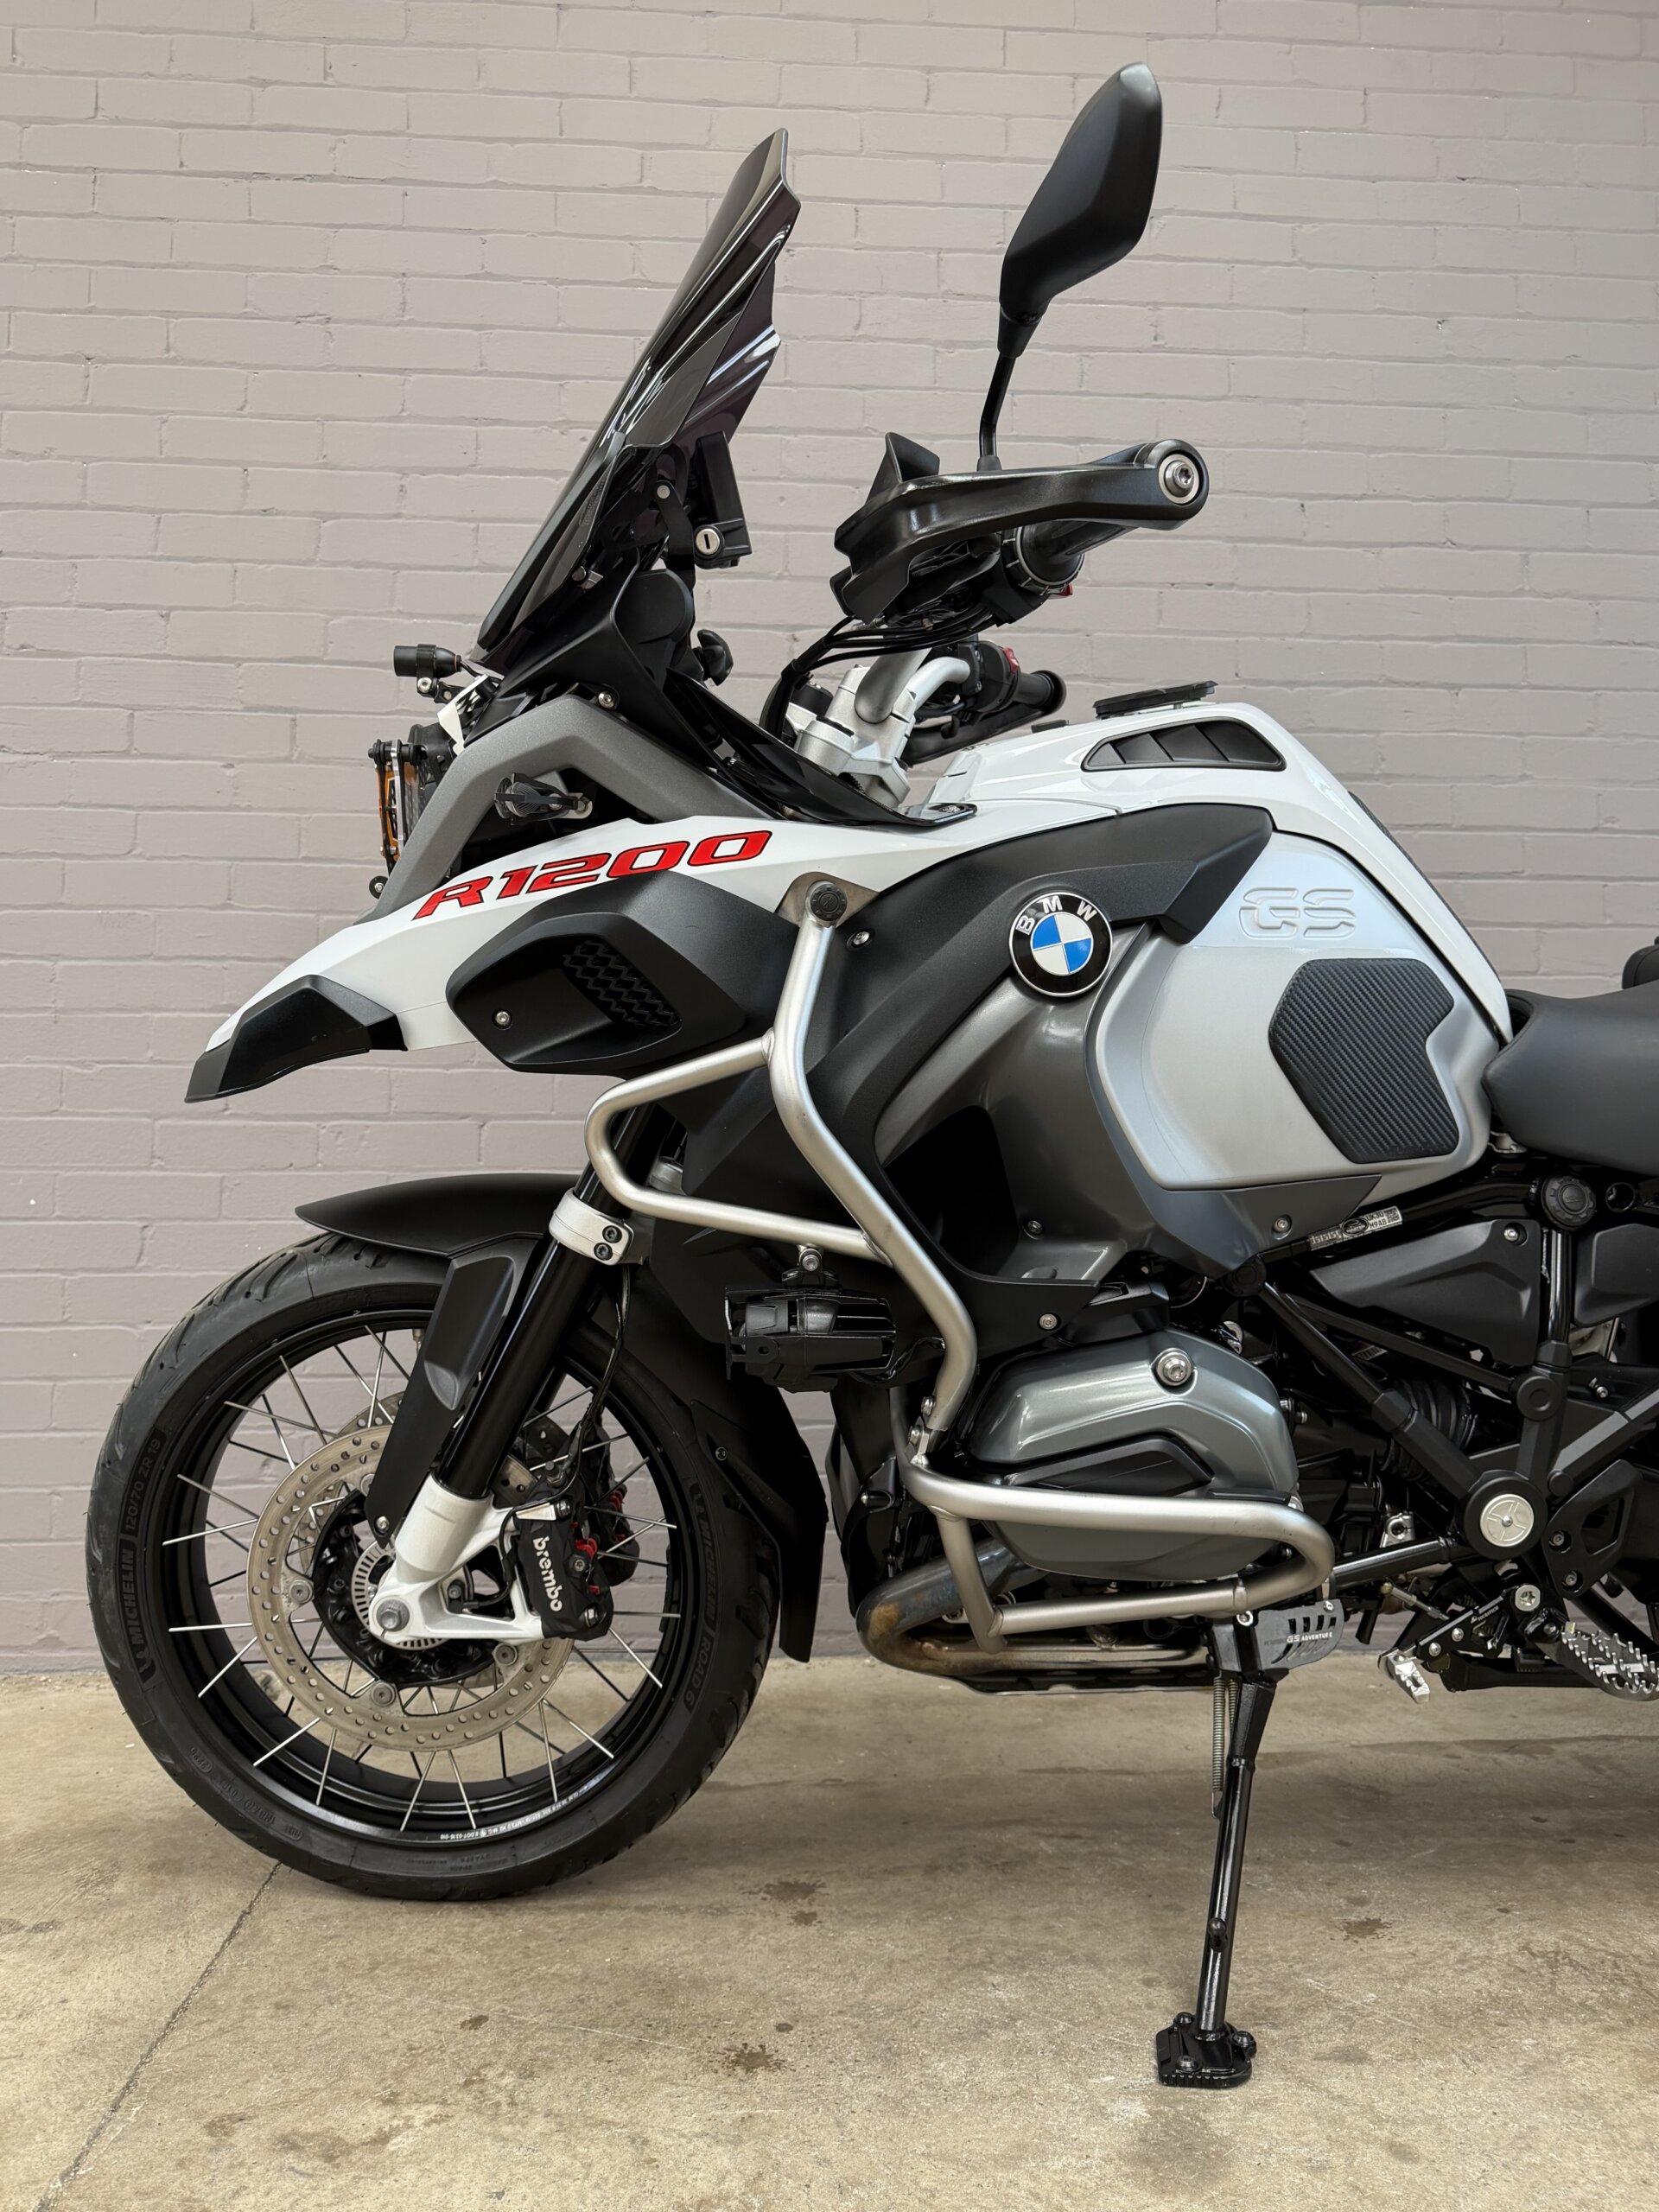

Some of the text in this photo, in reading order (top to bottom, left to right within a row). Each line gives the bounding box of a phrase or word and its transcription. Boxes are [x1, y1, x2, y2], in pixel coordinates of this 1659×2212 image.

[412, 830, 773, 921] R1200
[1015, 894, 1098, 936] BMW
[1239, 887, 1357, 941] GS
[125, 1438, 161, 1531] 120/70 ZR 19
[121, 1548, 144, 1645] MICHELIN
[532, 1535, 563, 1612] brembo
[685, 1518, 716, 1706] MICHELIN ROAD 6
[1287, 1634, 1300, 1643] GS
